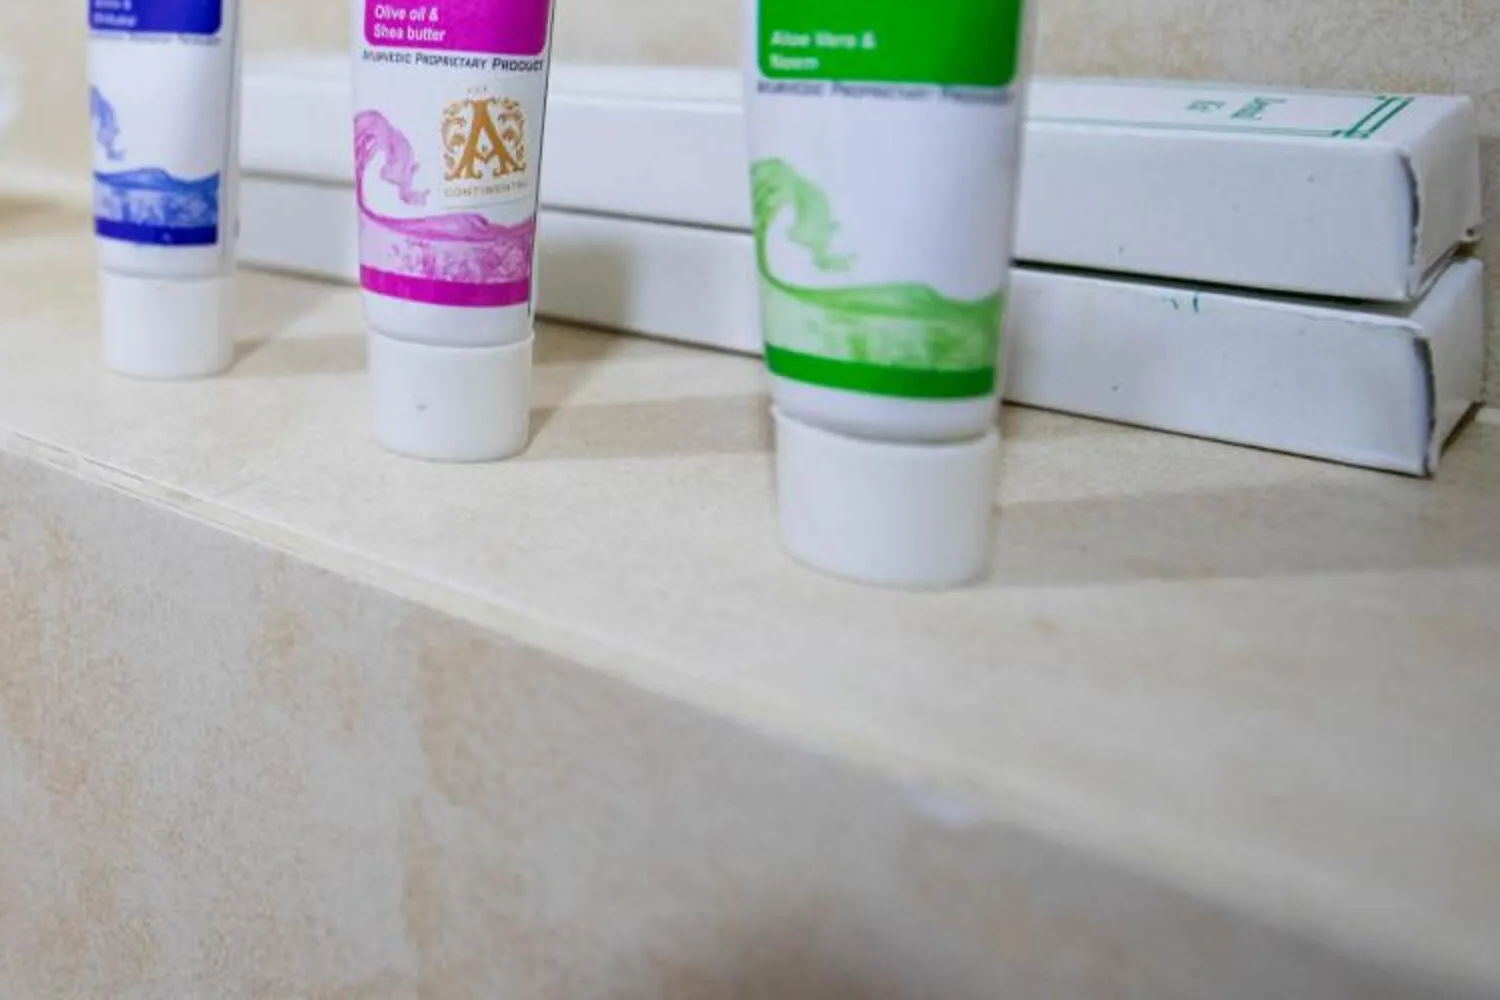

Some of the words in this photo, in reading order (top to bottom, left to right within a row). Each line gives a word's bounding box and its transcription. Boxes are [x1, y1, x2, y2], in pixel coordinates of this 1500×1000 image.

[374, 4, 406, 21] Olive
[409, 6, 426, 22] oil
[428, 7, 439, 22] &
[373, 24, 405, 40] Shea
[407, 25, 446, 42] butter
[415, 52, 487, 69] PROPRIETARY
[491, 57, 543, 73] PRODUCT
